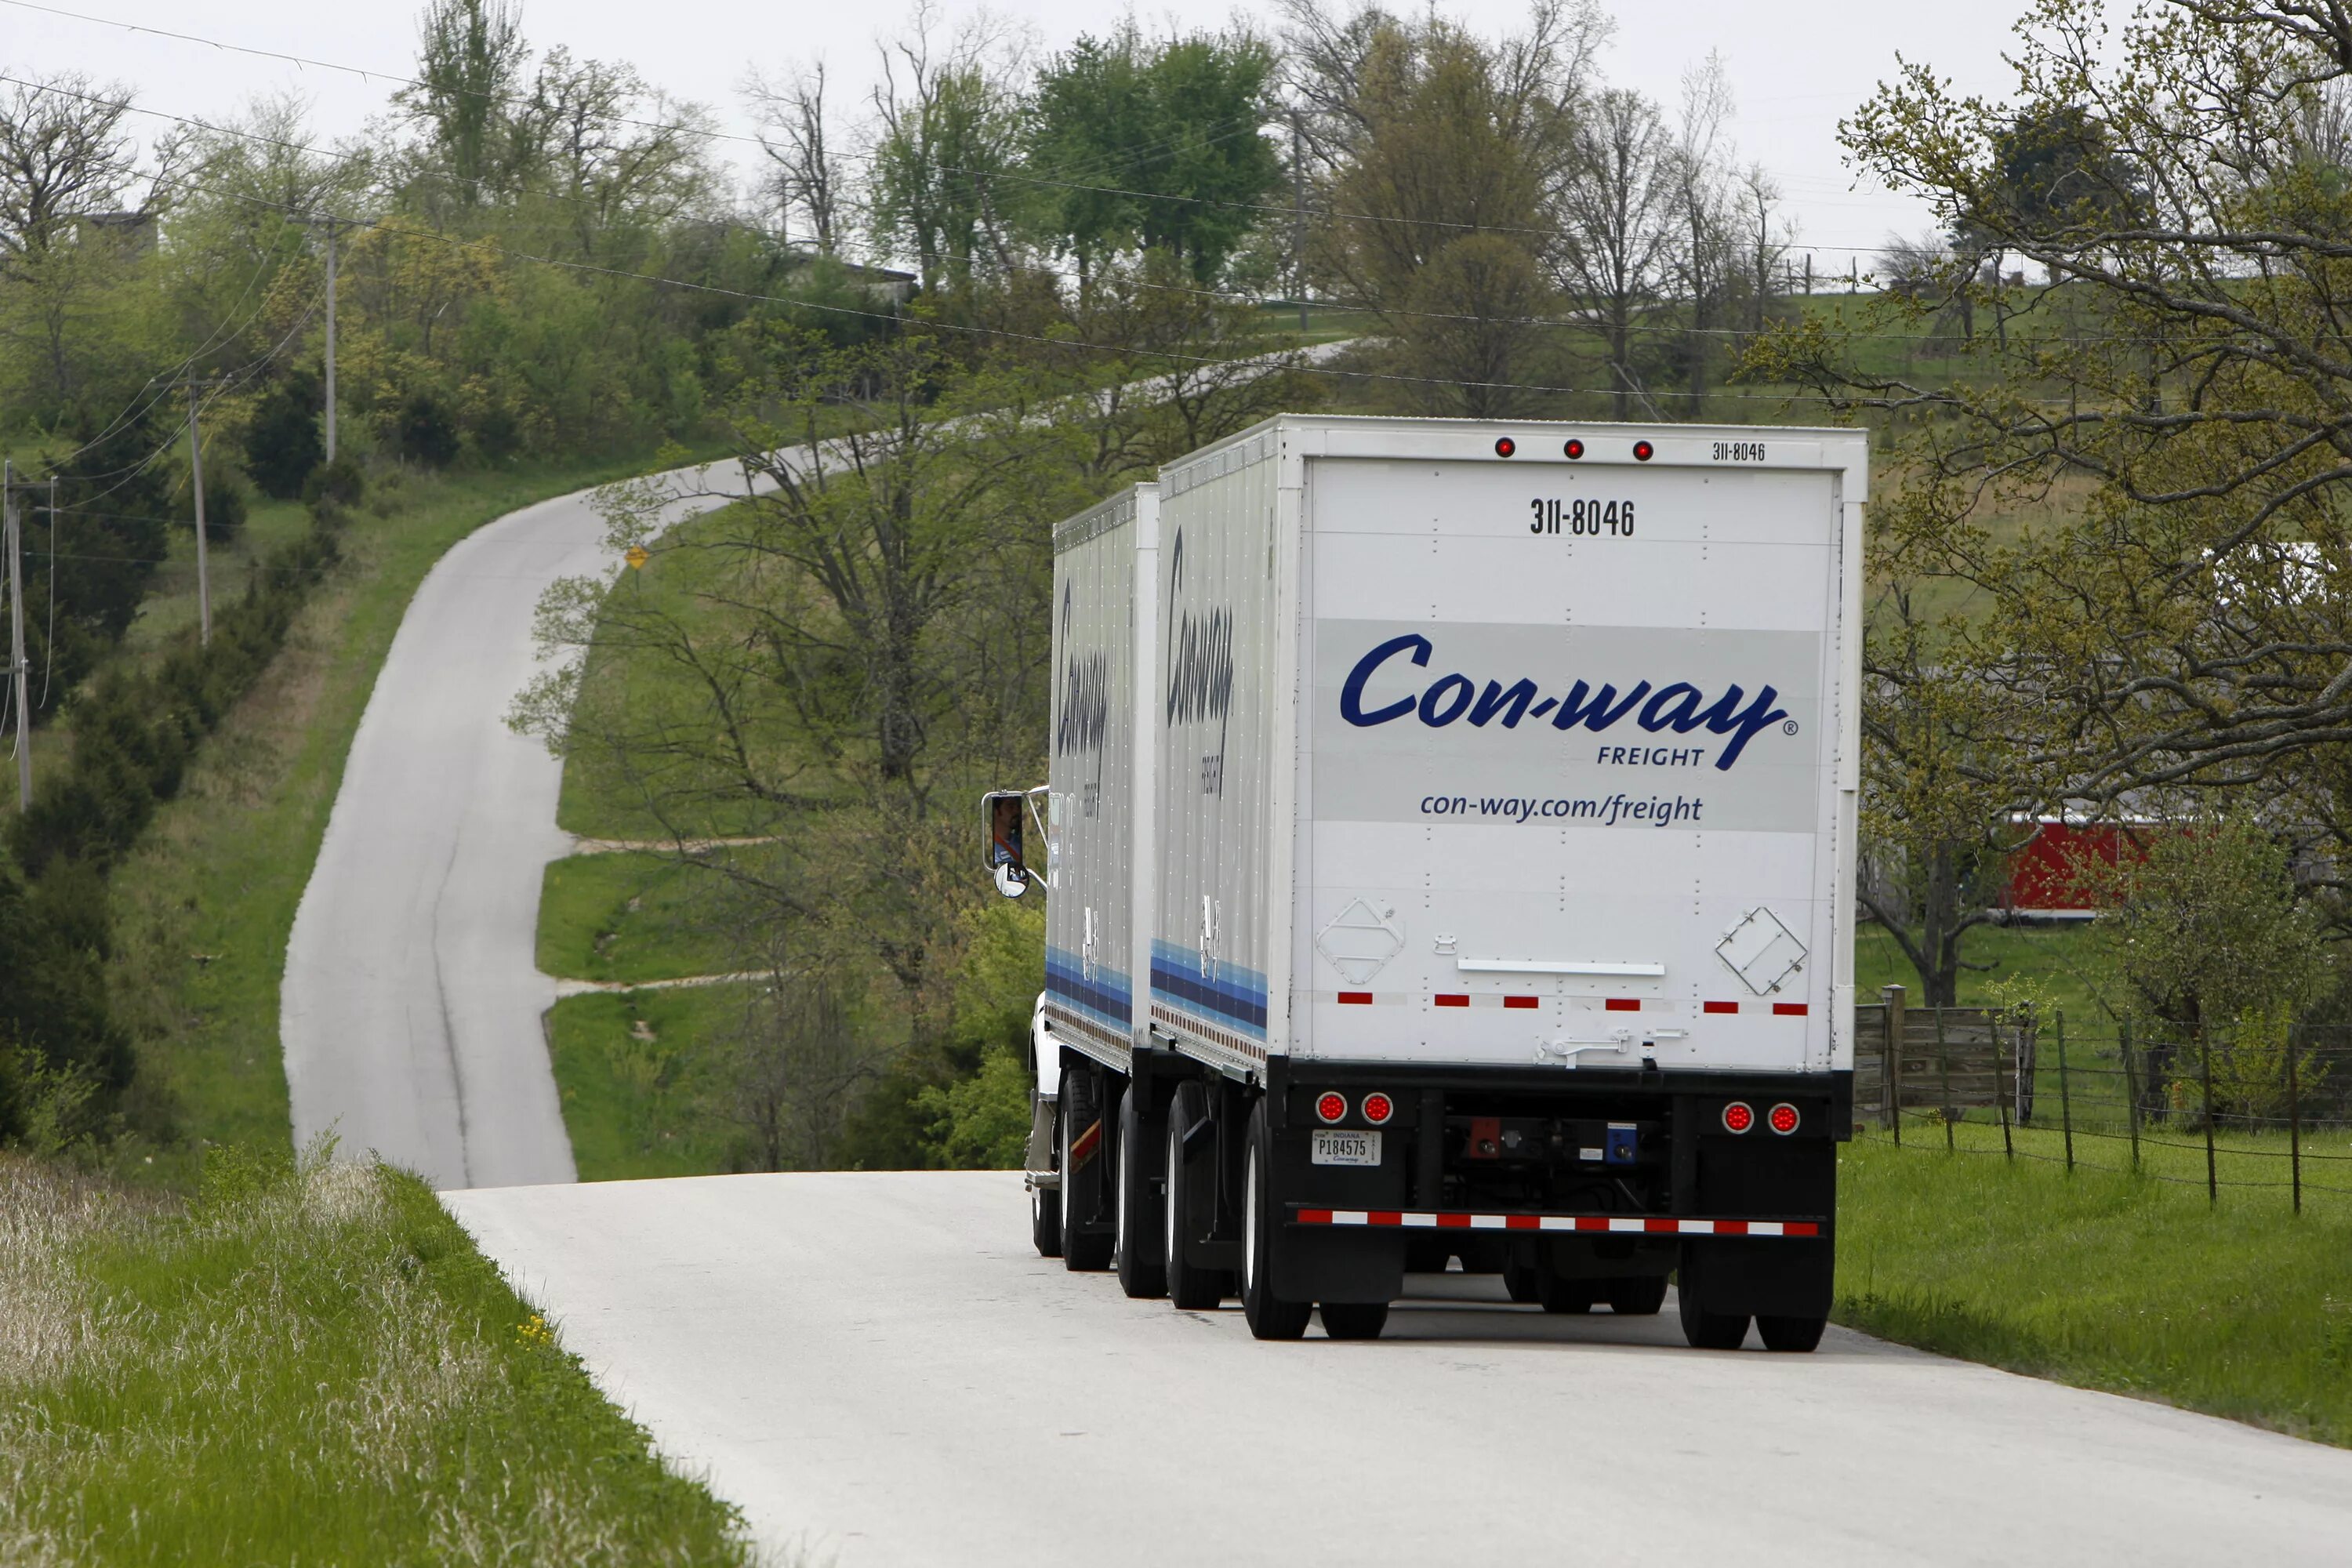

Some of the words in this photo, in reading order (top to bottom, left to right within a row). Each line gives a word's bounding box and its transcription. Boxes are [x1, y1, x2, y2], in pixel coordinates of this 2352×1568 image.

[1713, 442, 1765, 461] 311-8046
[1530, 499, 1635, 536] 311-8046
[1340, 633, 1789, 771] Con-way
[1597, 747, 1705, 767] FREIGHT
[1421, 794, 1704, 827] con-way.com/freight
[1319, 1139, 1367, 1156] P184575
